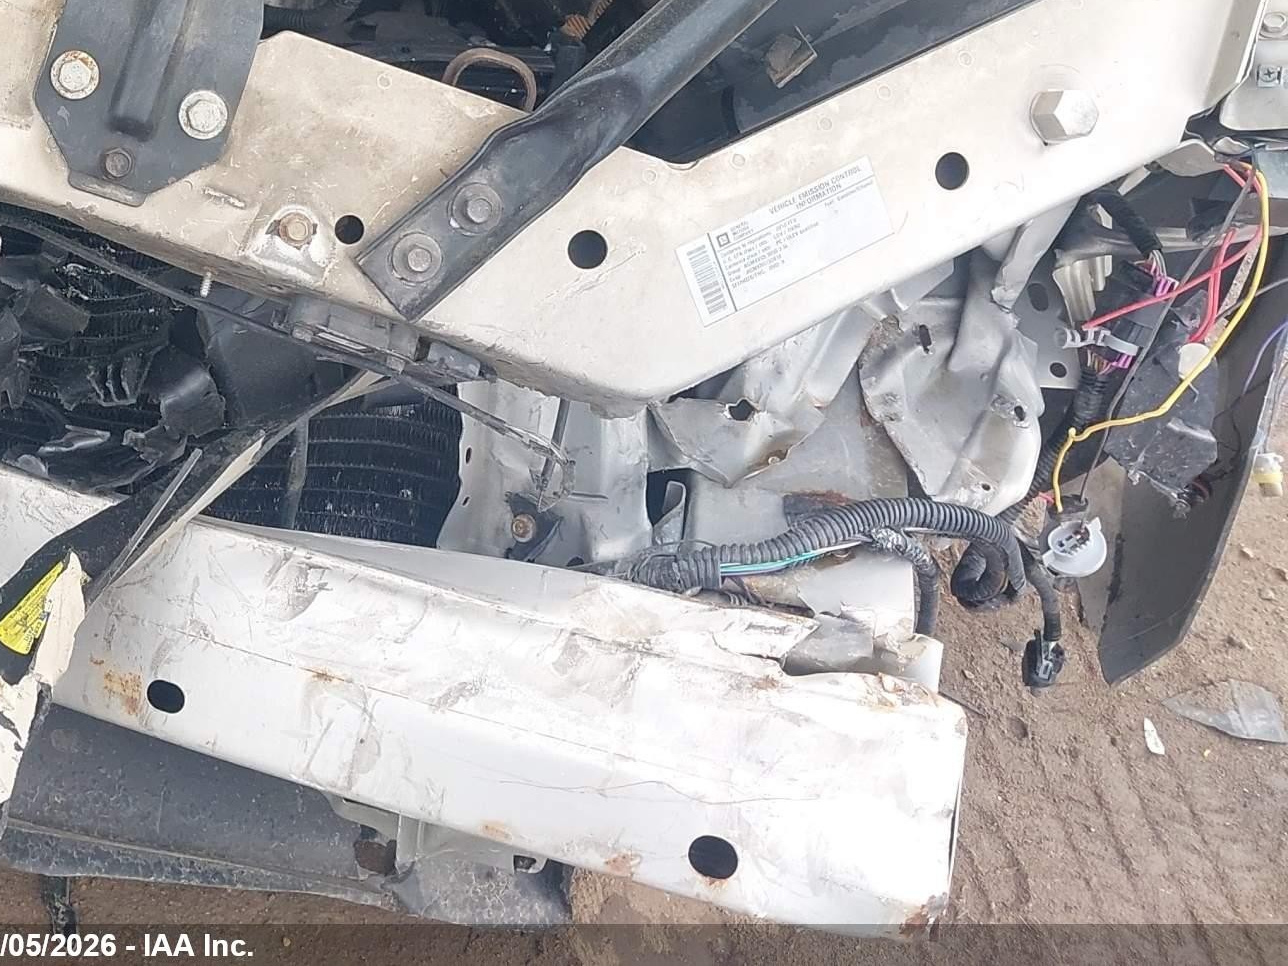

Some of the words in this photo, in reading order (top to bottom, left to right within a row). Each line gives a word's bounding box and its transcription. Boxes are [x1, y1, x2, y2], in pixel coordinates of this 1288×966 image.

[769, 197, 795, 214] VEHICLE
[798, 181, 830, 200] EMISSION
[831, 165, 861, 184] CONTROL
[796, 183, 842, 210] INFORMATION
